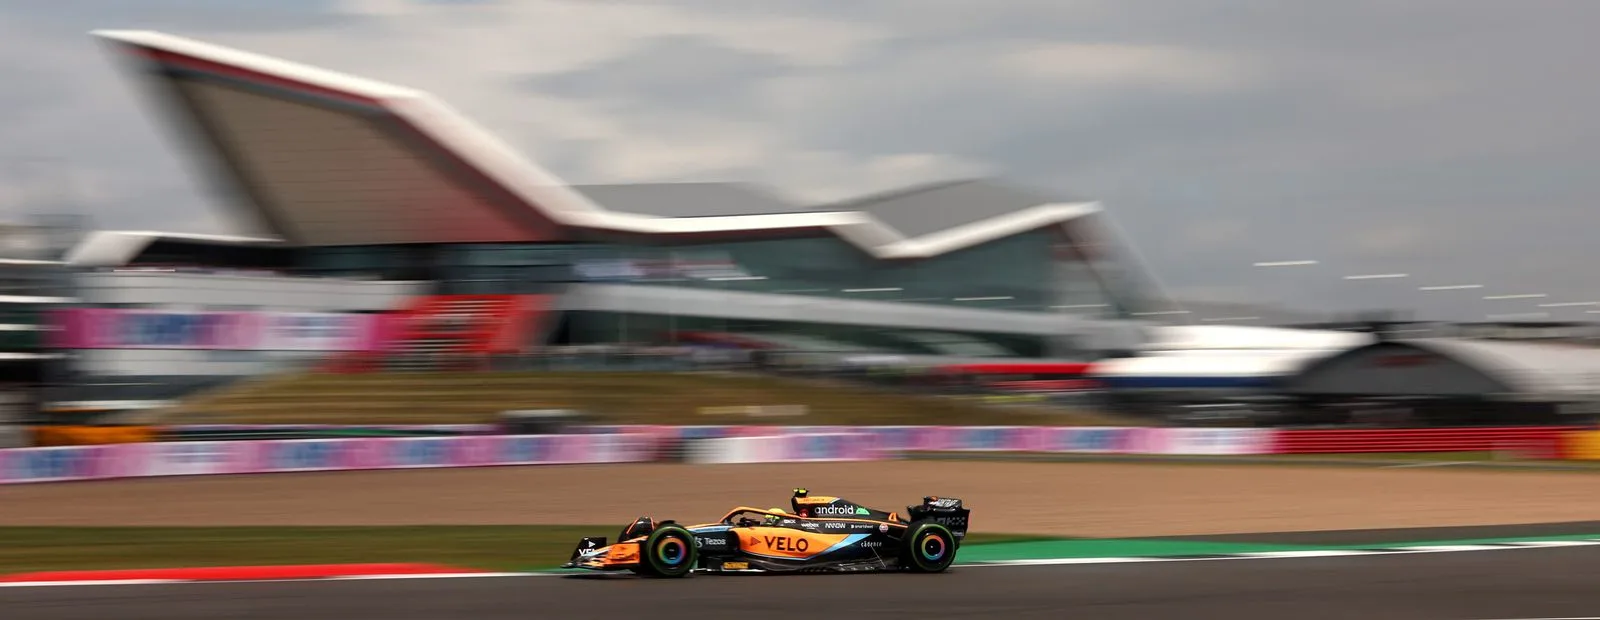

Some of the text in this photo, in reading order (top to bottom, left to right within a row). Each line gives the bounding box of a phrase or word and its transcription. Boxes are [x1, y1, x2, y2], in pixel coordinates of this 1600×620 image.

[814, 504, 854, 515] android
[888, 512, 897, 522] 4
[704, 537, 726, 545] Tezos
[764, 535, 809, 552] VELO
